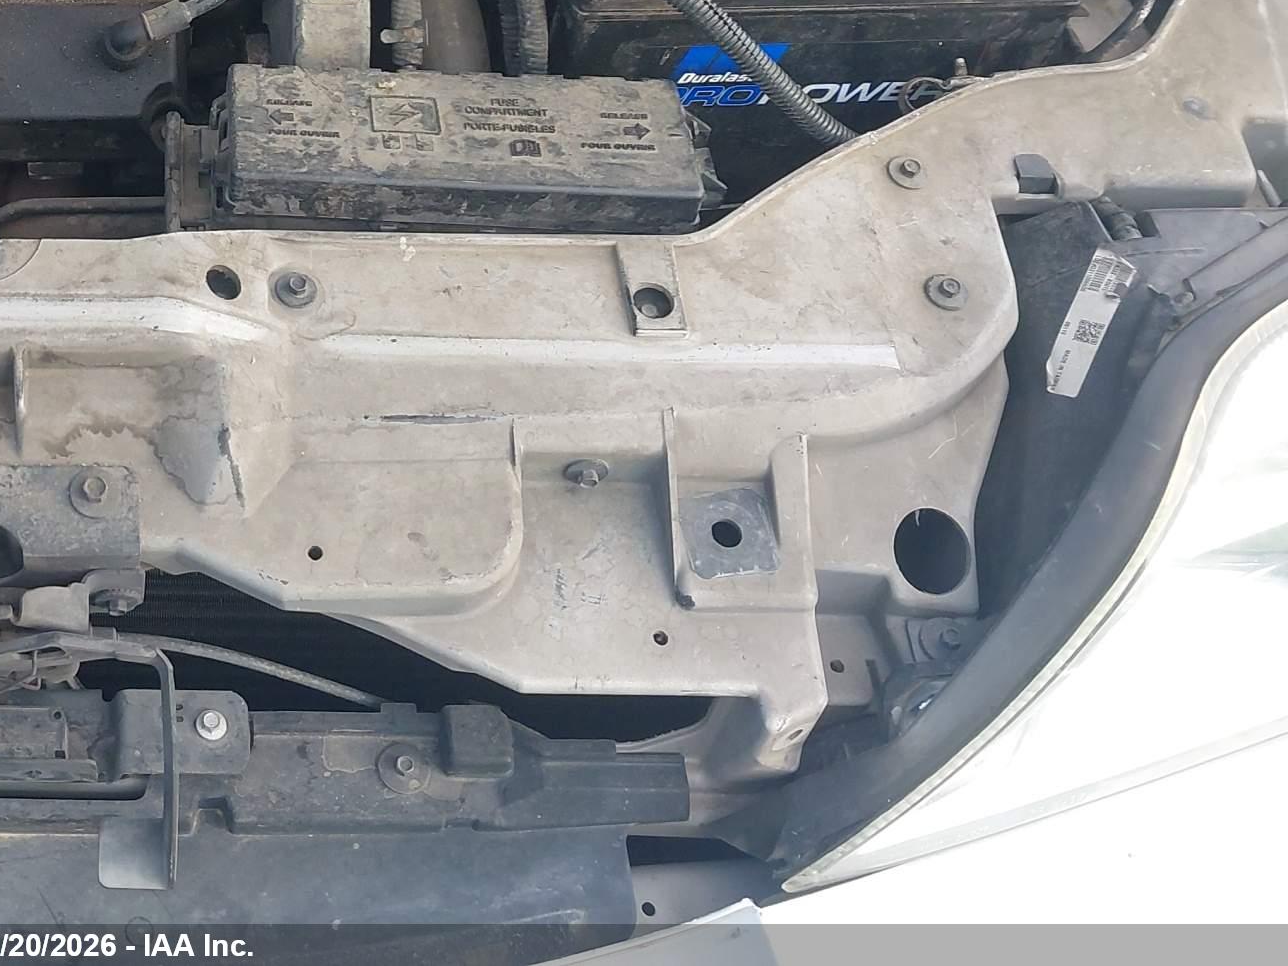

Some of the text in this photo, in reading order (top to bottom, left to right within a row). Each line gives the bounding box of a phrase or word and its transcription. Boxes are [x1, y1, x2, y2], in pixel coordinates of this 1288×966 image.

[678, 72, 753, 84] Duralas
[490, 98, 520, 107] FUSE
[465, 106, 548, 117] COMPARTMENT
